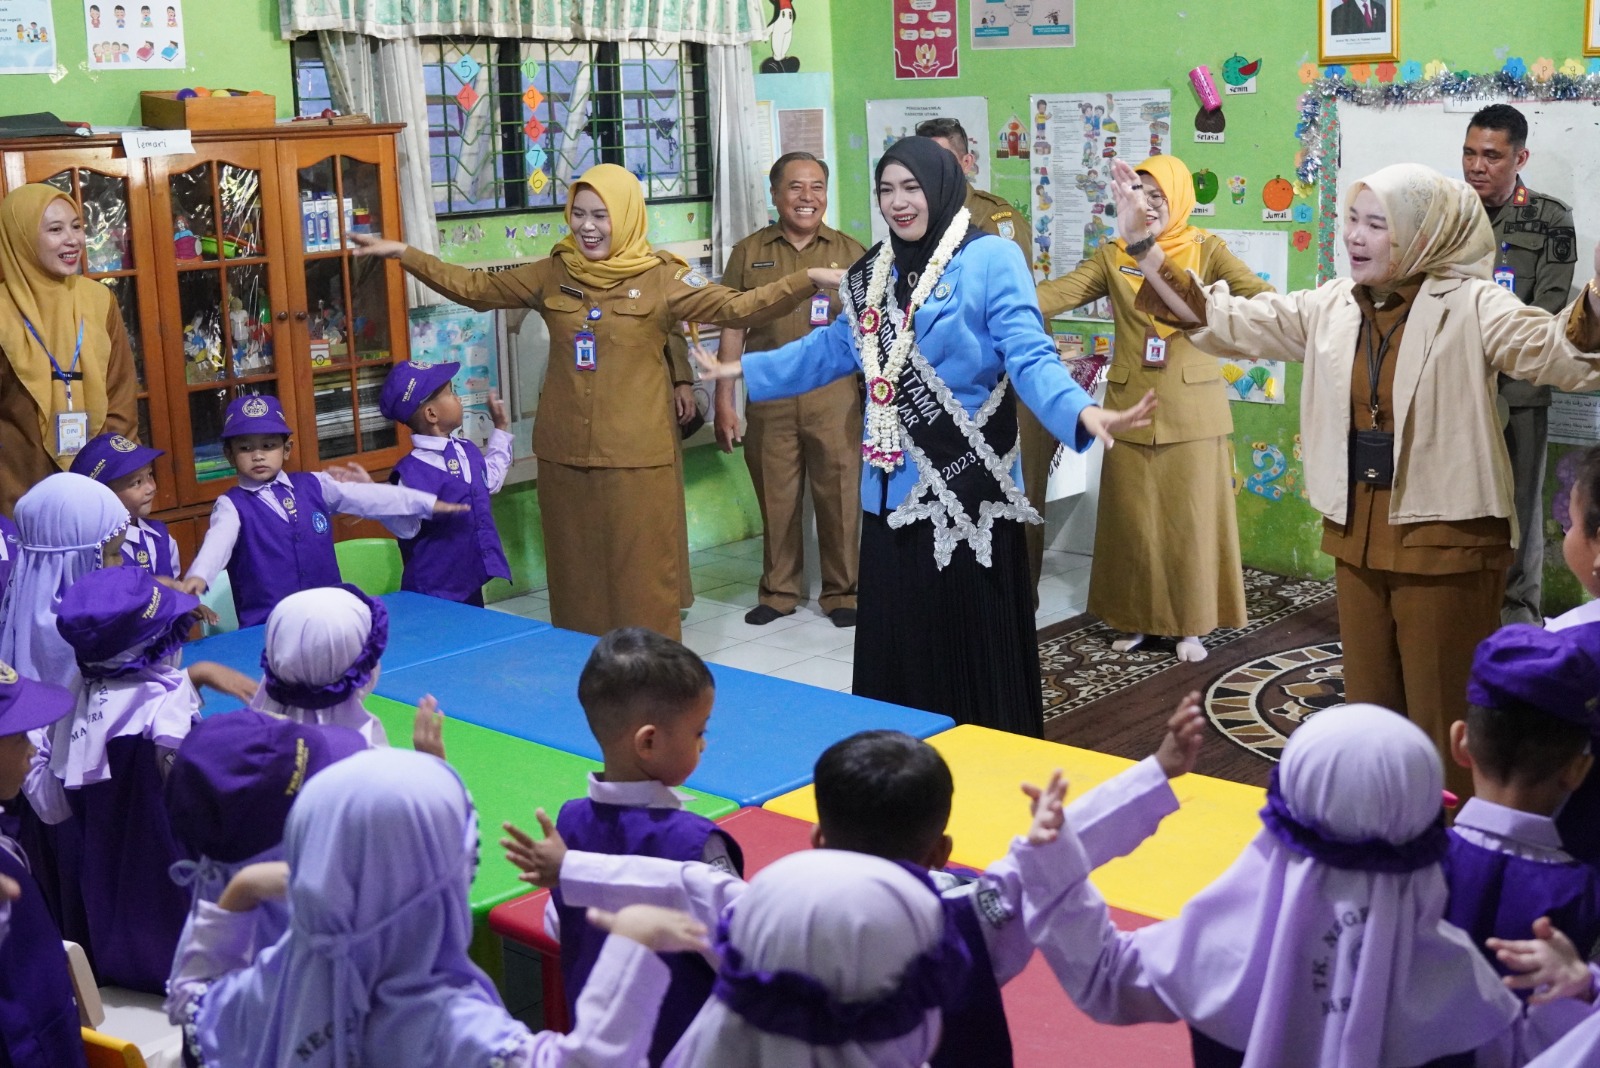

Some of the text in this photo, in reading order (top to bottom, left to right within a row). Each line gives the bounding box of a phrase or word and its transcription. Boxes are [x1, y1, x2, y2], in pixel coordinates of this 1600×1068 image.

[461, 61, 472, 79] 5
[524, 62, 536, 79] 10
[459, 92, 471, 110] 4
[527, 89, 536, 109] 9
[136, 137, 167, 149] lemari
[531, 149, 542, 167] 7
[532, 171, 543, 190] 6
[1191, 206, 1209, 214] amis
[850, 270, 867, 309] BUNDA
[942, 450, 977, 481] 2023
